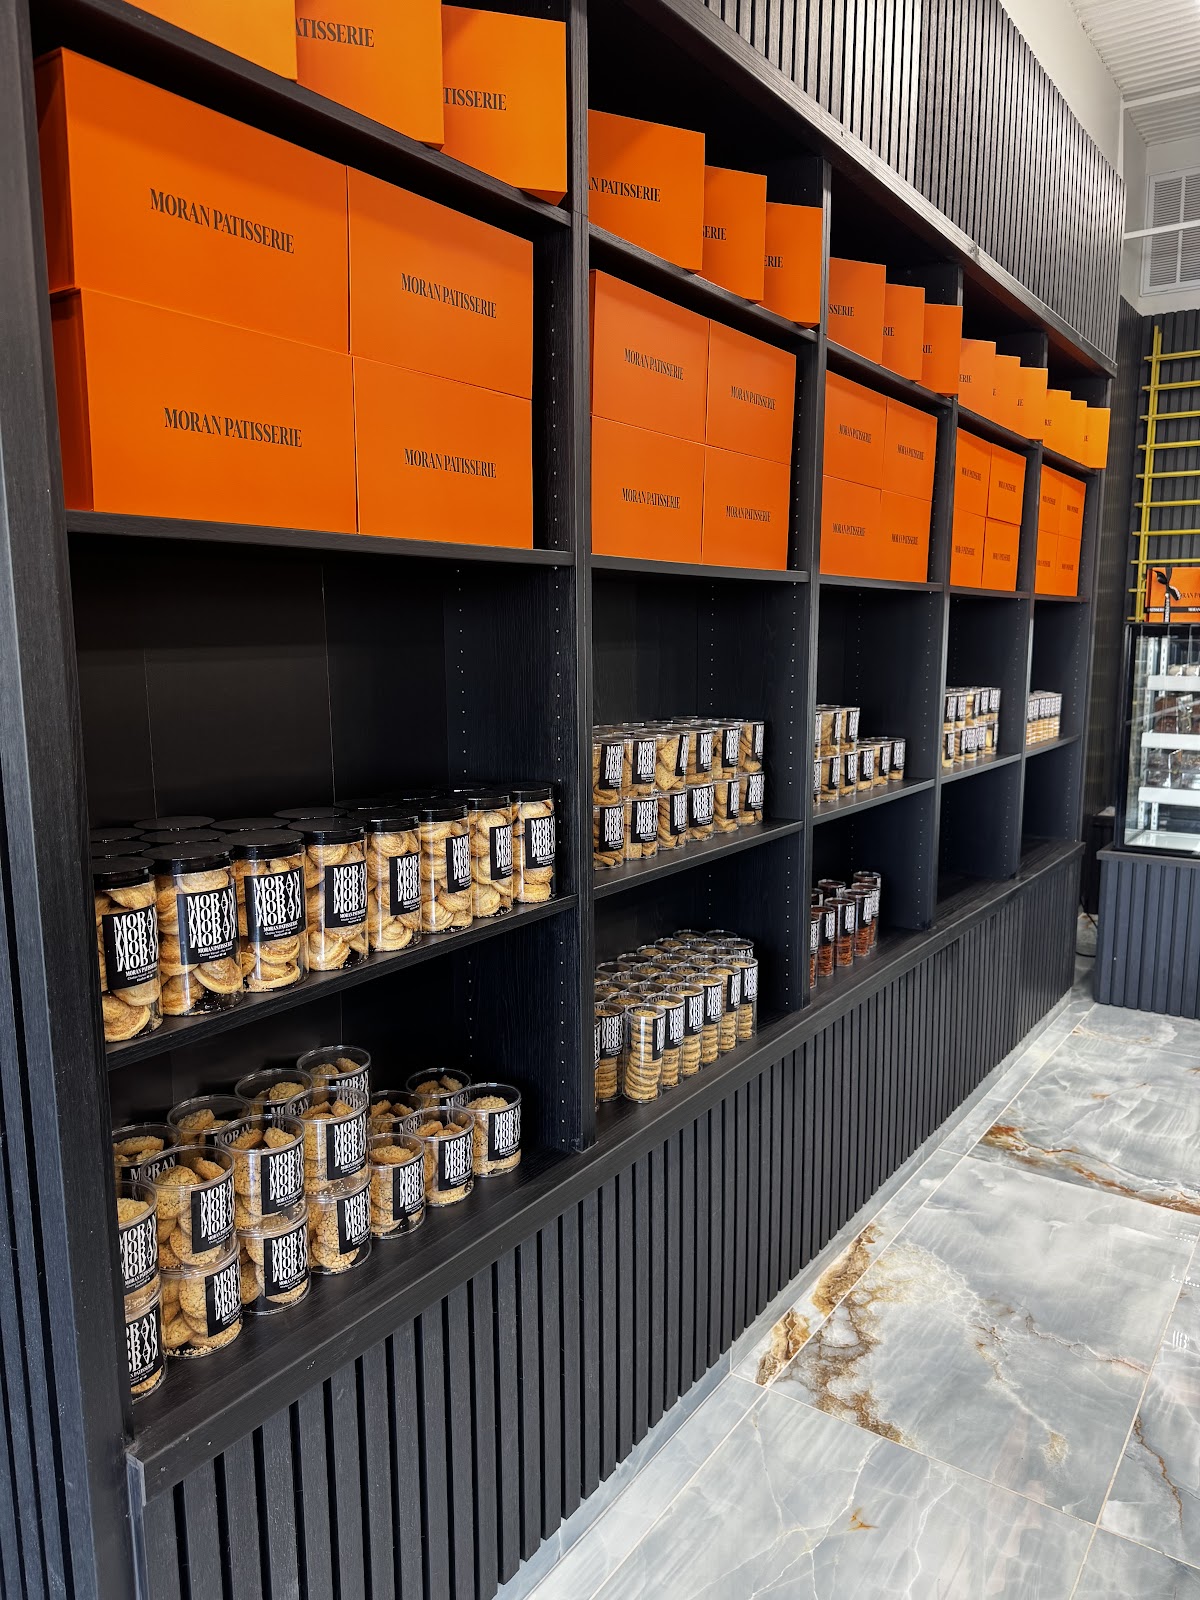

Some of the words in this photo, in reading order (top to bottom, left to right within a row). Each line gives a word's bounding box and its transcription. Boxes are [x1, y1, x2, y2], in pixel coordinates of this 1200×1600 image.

[601, 178, 661, 203] PATISSERIE
[150, 188, 210, 228] MORAN
[213, 209, 295, 254] PATISSERIE
[401, 273, 441, 302] MORAN
[443, 286, 497, 319] PATISSERIE
[624, 348, 649, 369] MORAN
[650, 356, 684, 381] PATISSERIE
[731, 385, 749, 401] MORAN
[749, 391, 776, 411] PATISSERIE
[164, 407, 222, 436] MORAN
[224, 417, 302, 448] PATISSERIE
[404, 448, 443, 470] MORAN
[444, 455, 497, 479] PATISSERIE
[622, 487, 647, 504] MORAN
[647, 492, 681, 509] PATISSERIE
[726, 505, 744, 519] MORAN
[744, 508, 771, 522] PATISSERIE
